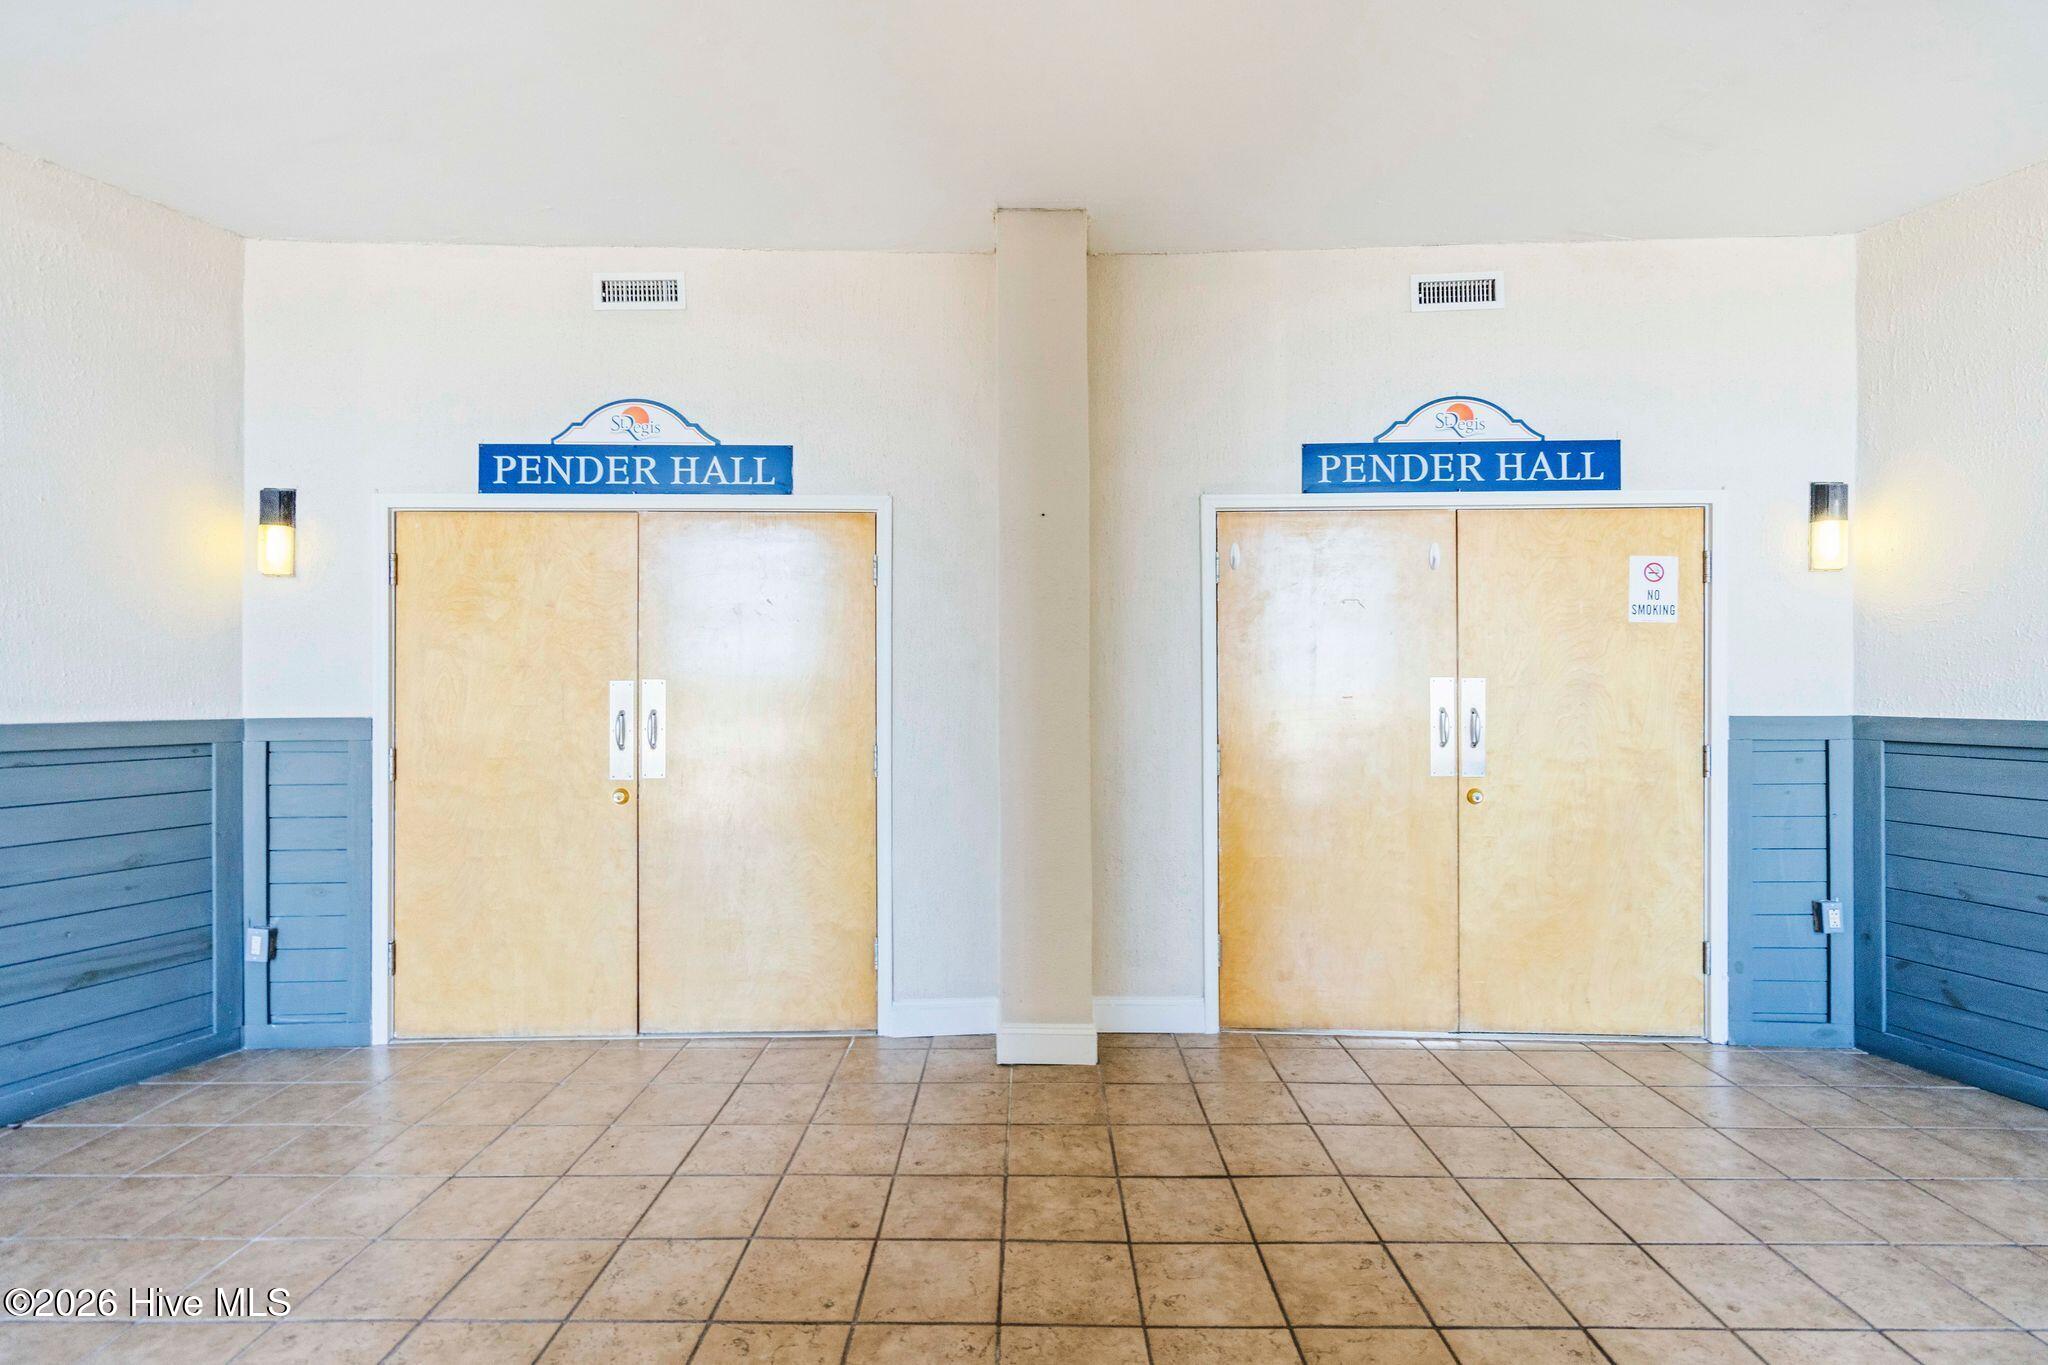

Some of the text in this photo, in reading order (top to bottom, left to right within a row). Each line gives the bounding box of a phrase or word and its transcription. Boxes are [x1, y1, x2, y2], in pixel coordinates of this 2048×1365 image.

[623, 415, 661, 441] Regis
[1446, 413, 1486, 438] Regis
[492, 455, 776, 485] PENDER HALL
[1317, 451, 1605, 483] PENDER HALL
[1647, 589, 1660, 601] NO
[1631, 604, 1676, 616] SMOKING
